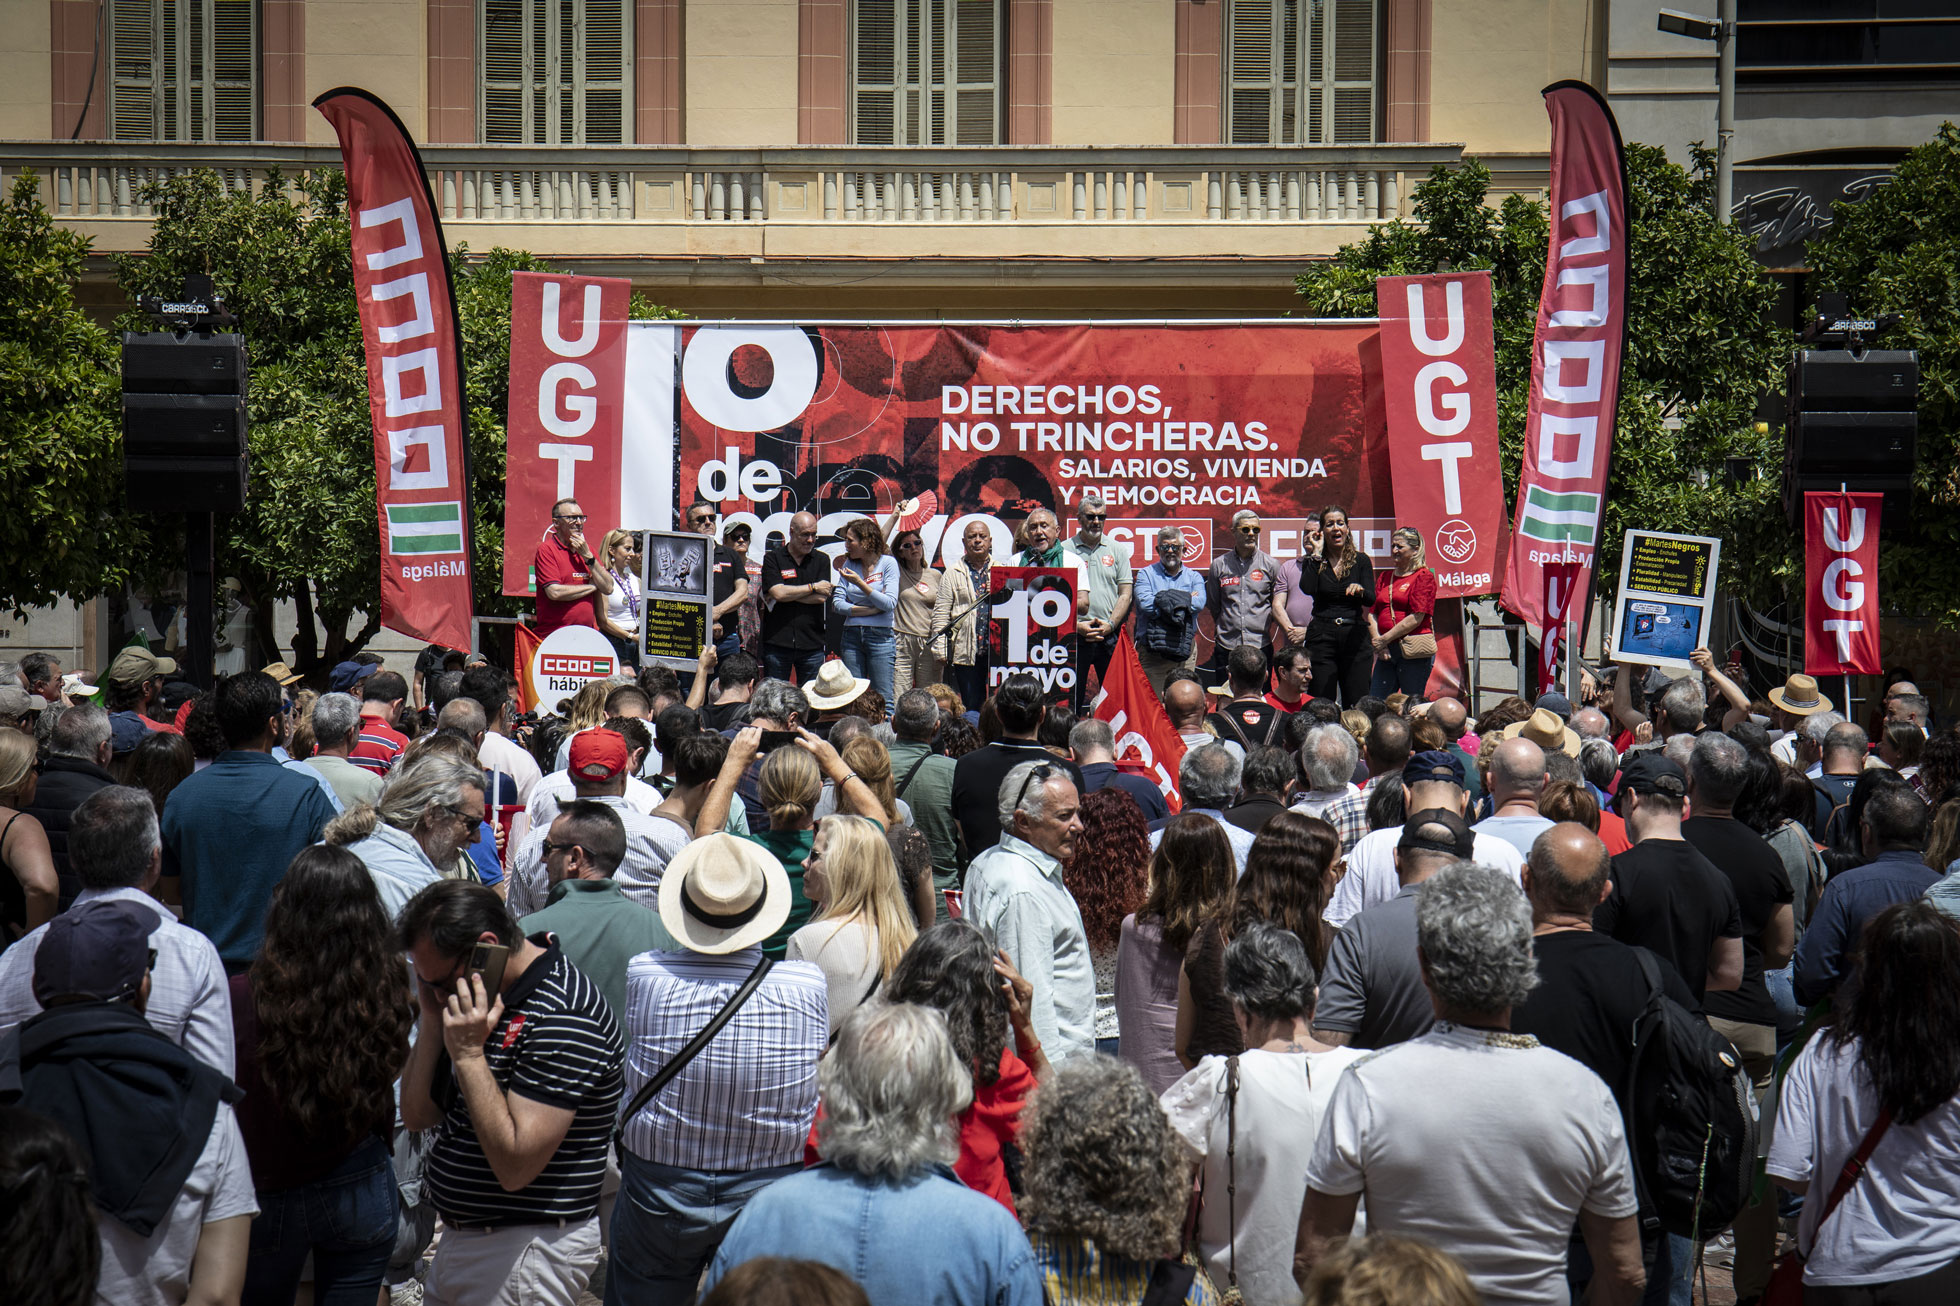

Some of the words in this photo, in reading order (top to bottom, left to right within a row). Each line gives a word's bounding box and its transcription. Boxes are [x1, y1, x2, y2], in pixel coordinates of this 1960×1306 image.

[538, 281, 602, 501] UGT
[941, 384, 1173, 420] DERECHOS,
[1406, 281, 1473, 515] UGT
[941, 421, 1001, 452] NO
[1010, 421, 1279, 452] TRINCHERAS.
[697, 446, 783, 503] de
[1058, 458, 1197, 482] SALARIOS,
[1202, 458, 1328, 478] VIVIENDA
[1058, 485, 1077, 505] Y
[1082, 485, 1262, 506] DEMOCRACIA
[1076, 526, 1161, 562] GT
[1644, 537, 1701, 552] #MartesNegros
[1438, 570, 1491, 589] Málaga
[1633, 583, 1657, 592] SERVICIO
[1821, 507, 1867, 664] UGT
[543, 658, 591, 673] CCOO
[1029, 638, 1069, 665] de
